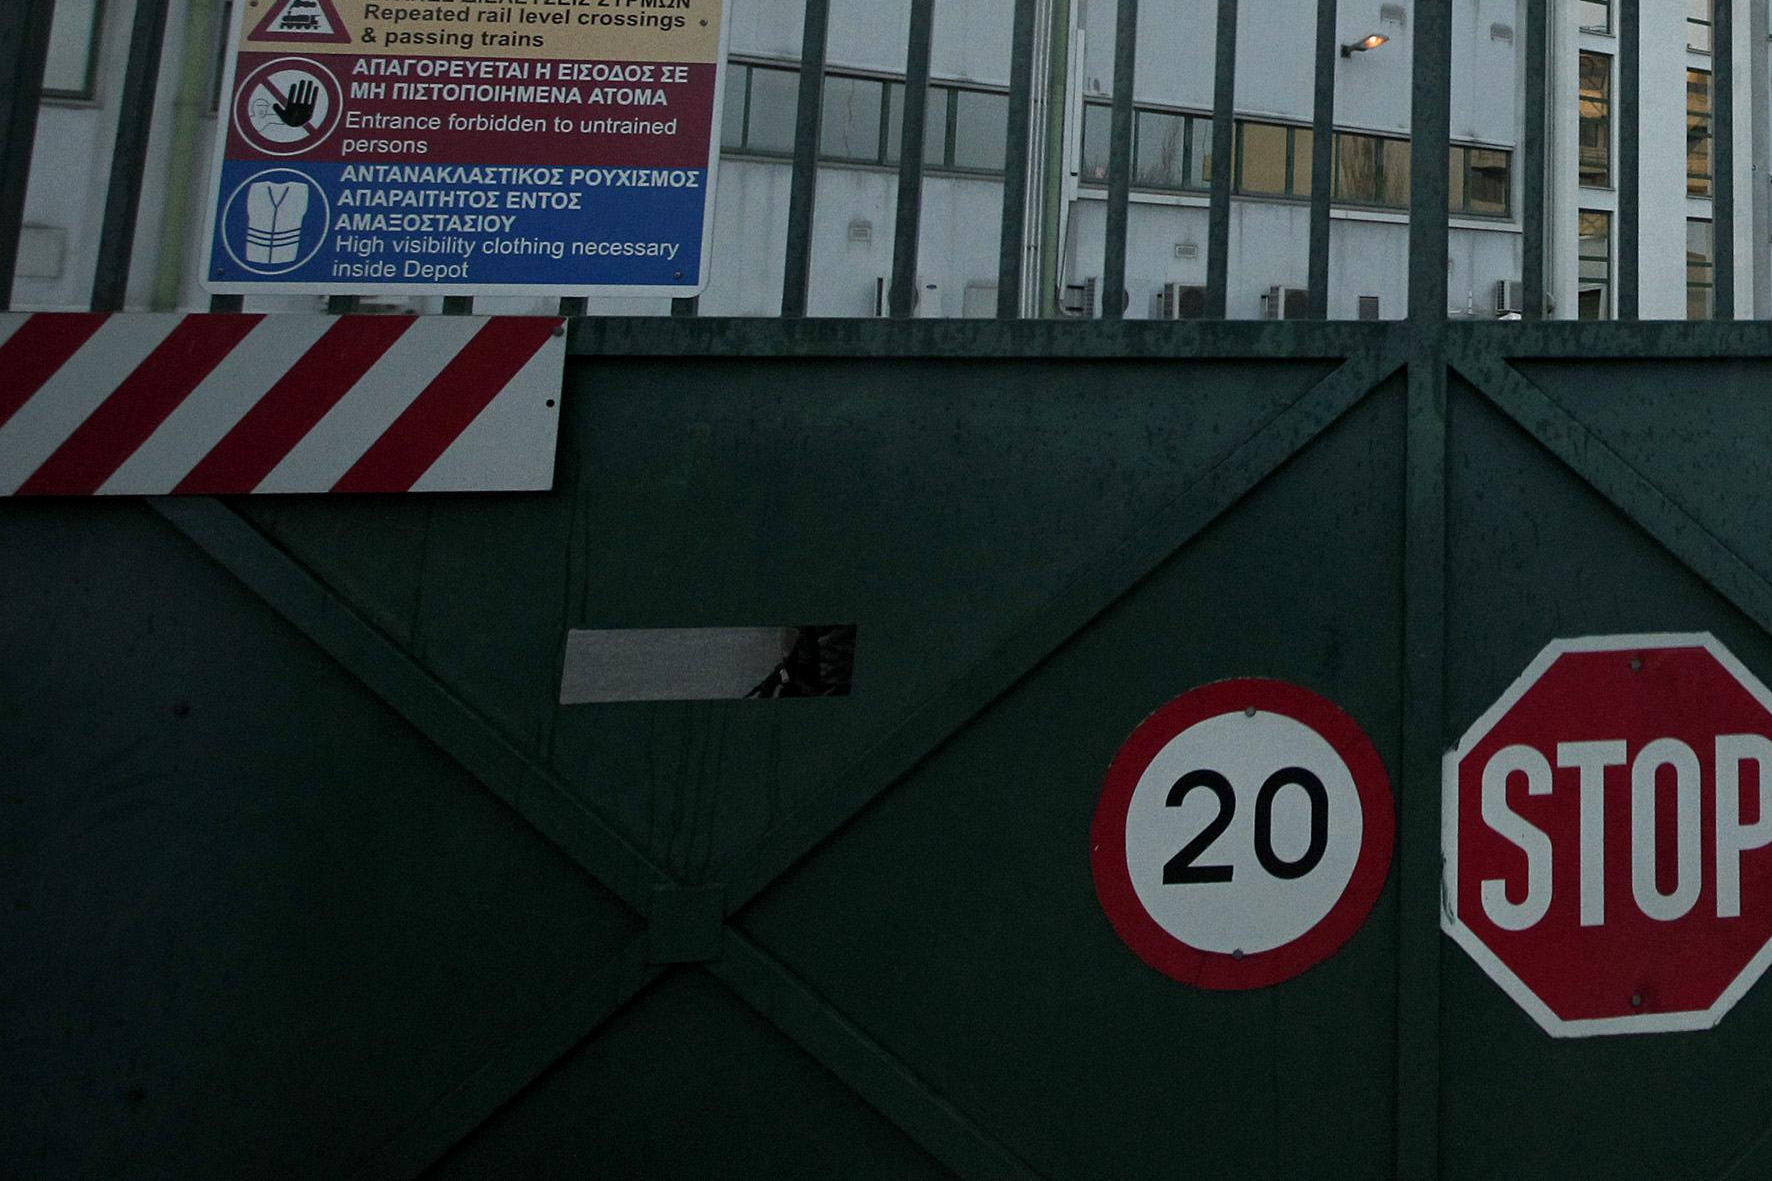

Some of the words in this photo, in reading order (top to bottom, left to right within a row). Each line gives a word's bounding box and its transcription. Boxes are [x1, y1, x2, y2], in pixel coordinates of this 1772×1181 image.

[364, 4, 470, 25] Repeated
[477, 7, 513, 24] rail
[518, 8, 571, 26] level
[577, 10, 686, 31] crossings
[361, 28, 377, 44] &
[384, 30, 474, 50] passing
[480, 31, 544, 48] trains
[352, 58, 529, 79] ΑΠΑΓΟΡΕΥΕΤΑΙ
[536, 63, 551, 80] Η
[557, 64, 655, 82] ΕΙΣΟΔΟΣ
[660, 66, 688, 83] ΣΕ
[350, 82, 387, 100] ΜΗ
[392, 83, 582, 103] ΠΙΣΤΟΠΟΙΗΜΕΝΑ
[587, 88, 668, 106] ΑΤΟΜΑ
[345, 111, 441, 131] Entrance
[447, 114, 547, 133] forbidden
[553, 118, 574, 134] to
[579, 117, 677, 135] untrained
[341, 137, 428, 157] persons
[340, 165, 563, 185] ΑΝΤΑΝΑΚΛΑΣΤΙΚΟΣ
[570, 169, 699, 188] ΡΟΥΧΙΣΜΟΣ
[337, 189, 500, 208] ΑΠΑΡΑΙΤΗΤΟΣ
[506, 192, 581, 210] ΕΝΤΟΣ
[334, 213, 516, 232] ΑΜΑΞΟΣΤΑΣΙΟΥ
[335, 235, 386, 257] High
[393, 237, 477, 258] visibility
[481, 237, 564, 259] clothing
[571, 240, 679, 261] necessary
[332, 259, 397, 279] inside
[403, 260, 469, 282] Depot
[1162, 766, 1329, 885] 20
